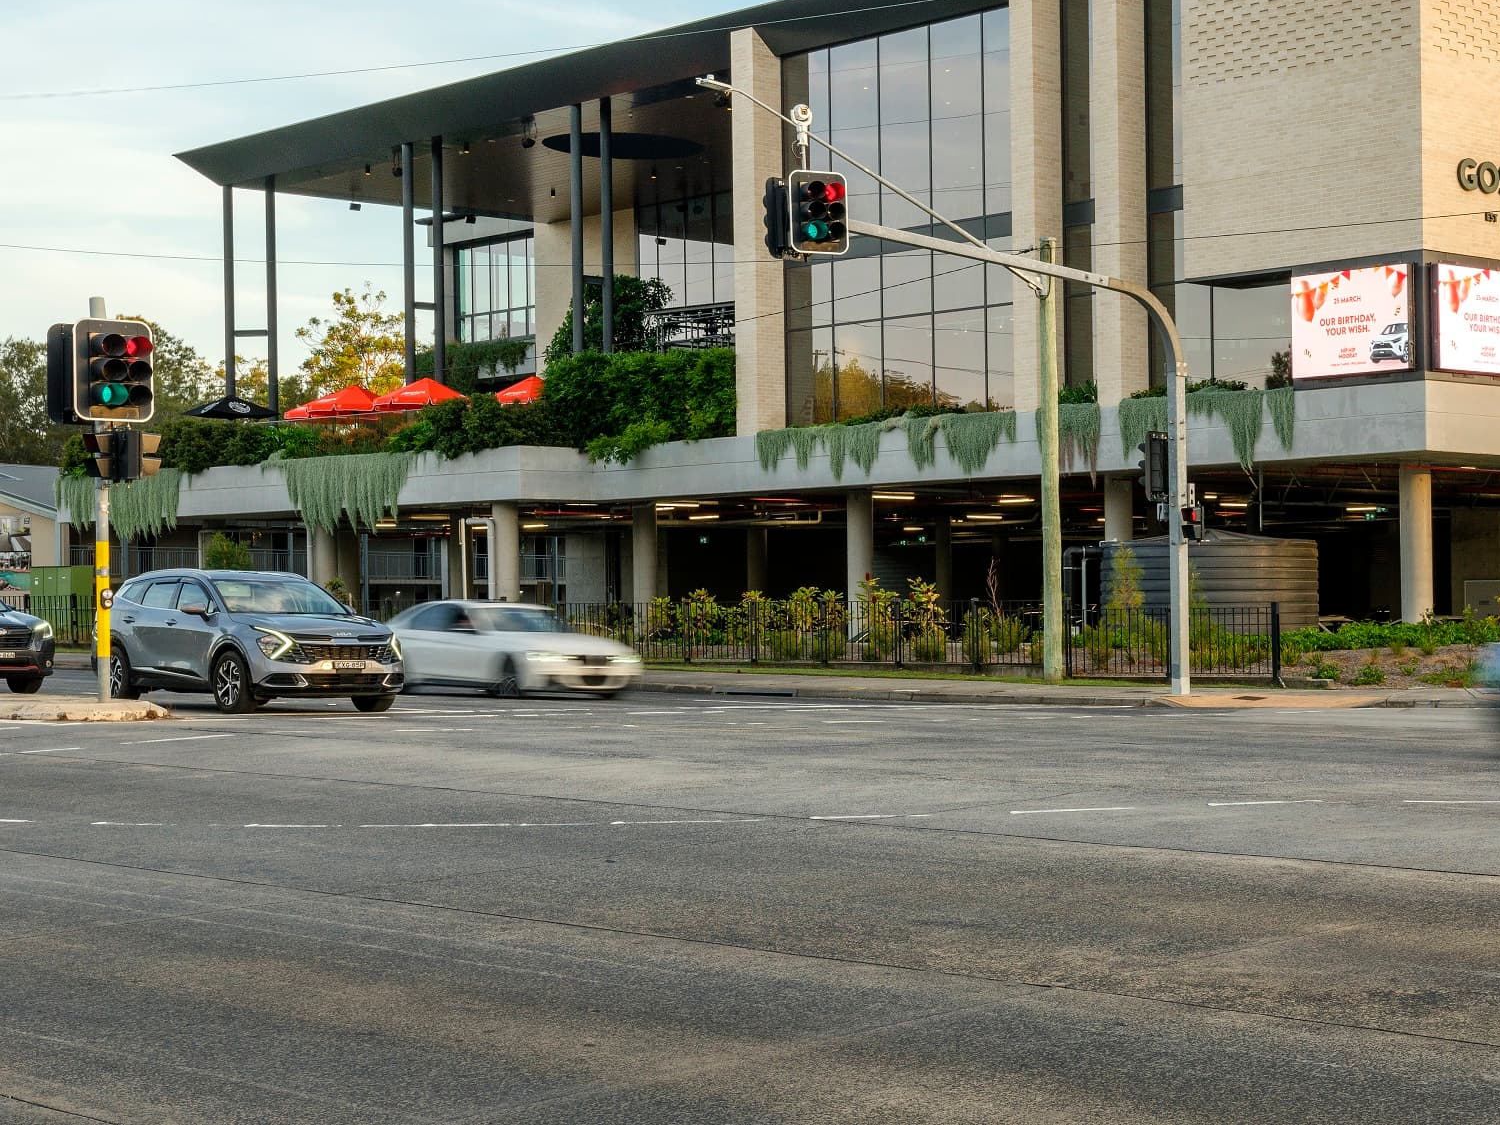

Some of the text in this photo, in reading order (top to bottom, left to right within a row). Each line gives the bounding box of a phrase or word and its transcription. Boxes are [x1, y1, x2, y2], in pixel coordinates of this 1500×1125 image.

[1341, 295, 1361, 303] MARCH
[1482, 295, 1499, 303] MARCH
[1320, 317, 1336, 327] OUR
[1464, 312, 1478, 322] OUR
[1325, 324, 1371, 336] YOUR WISH.
[1469, 323, 1487, 333] YOUR
